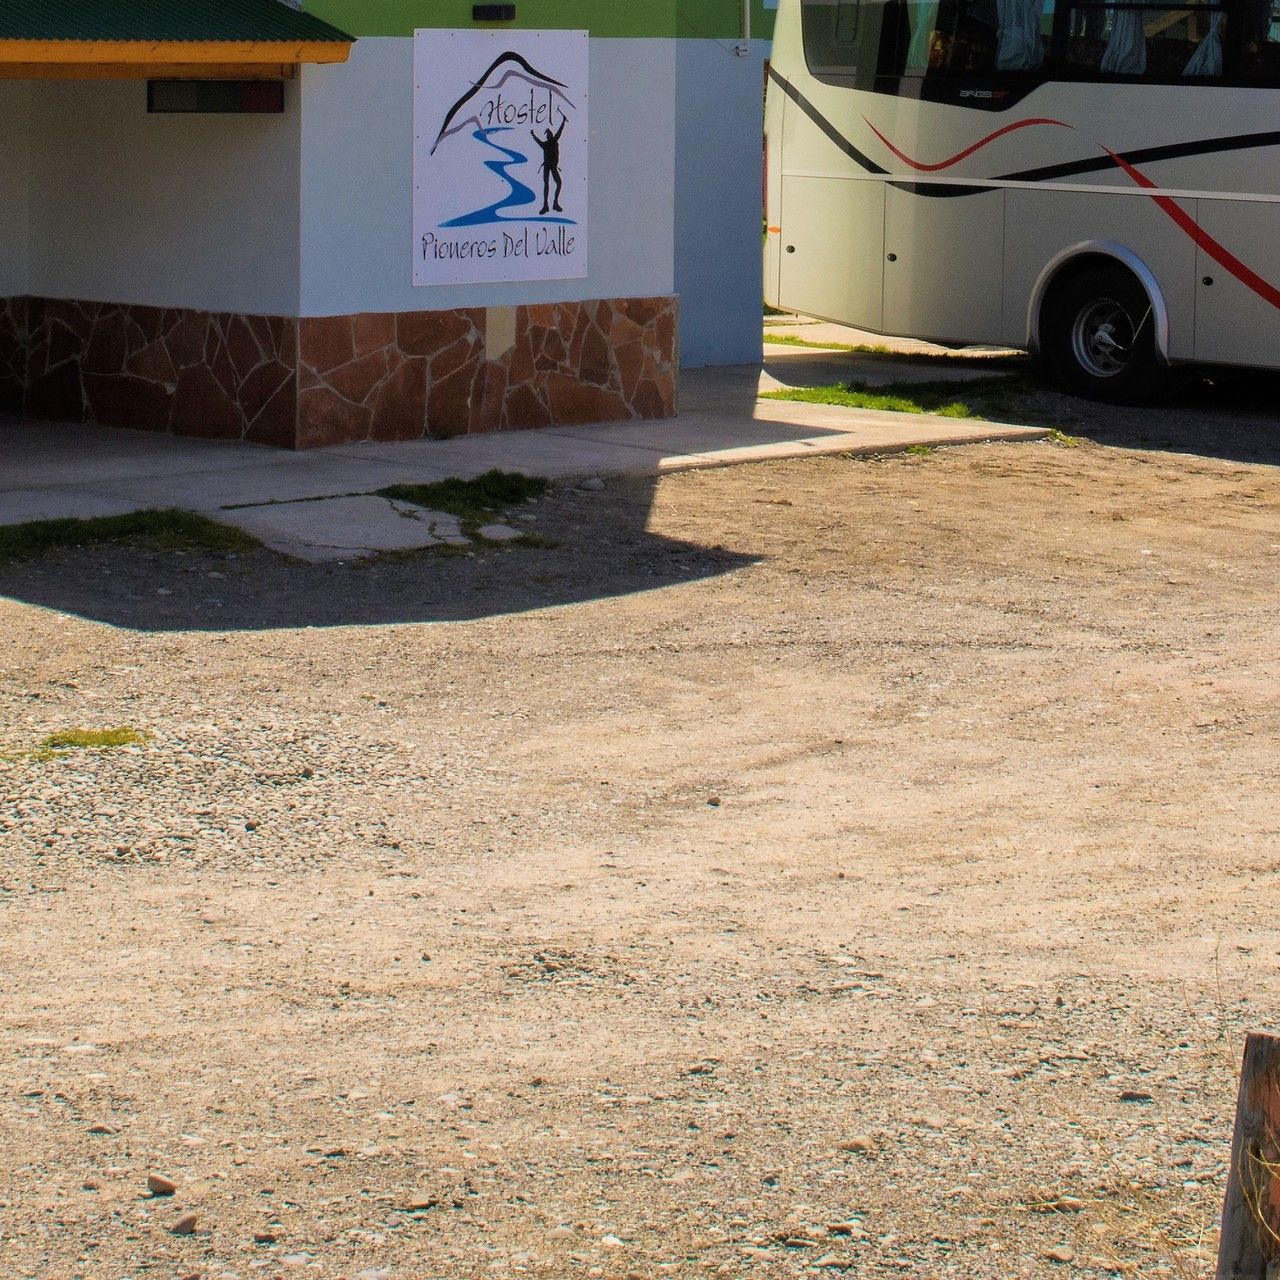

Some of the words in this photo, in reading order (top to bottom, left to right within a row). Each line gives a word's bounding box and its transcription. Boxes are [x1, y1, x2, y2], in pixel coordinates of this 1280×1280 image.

[479, 88, 555, 126] Hostel
[421, 231, 497, 261] Pioneros
[503, 227, 529, 259] Del
[536, 224, 577, 257] Valle
